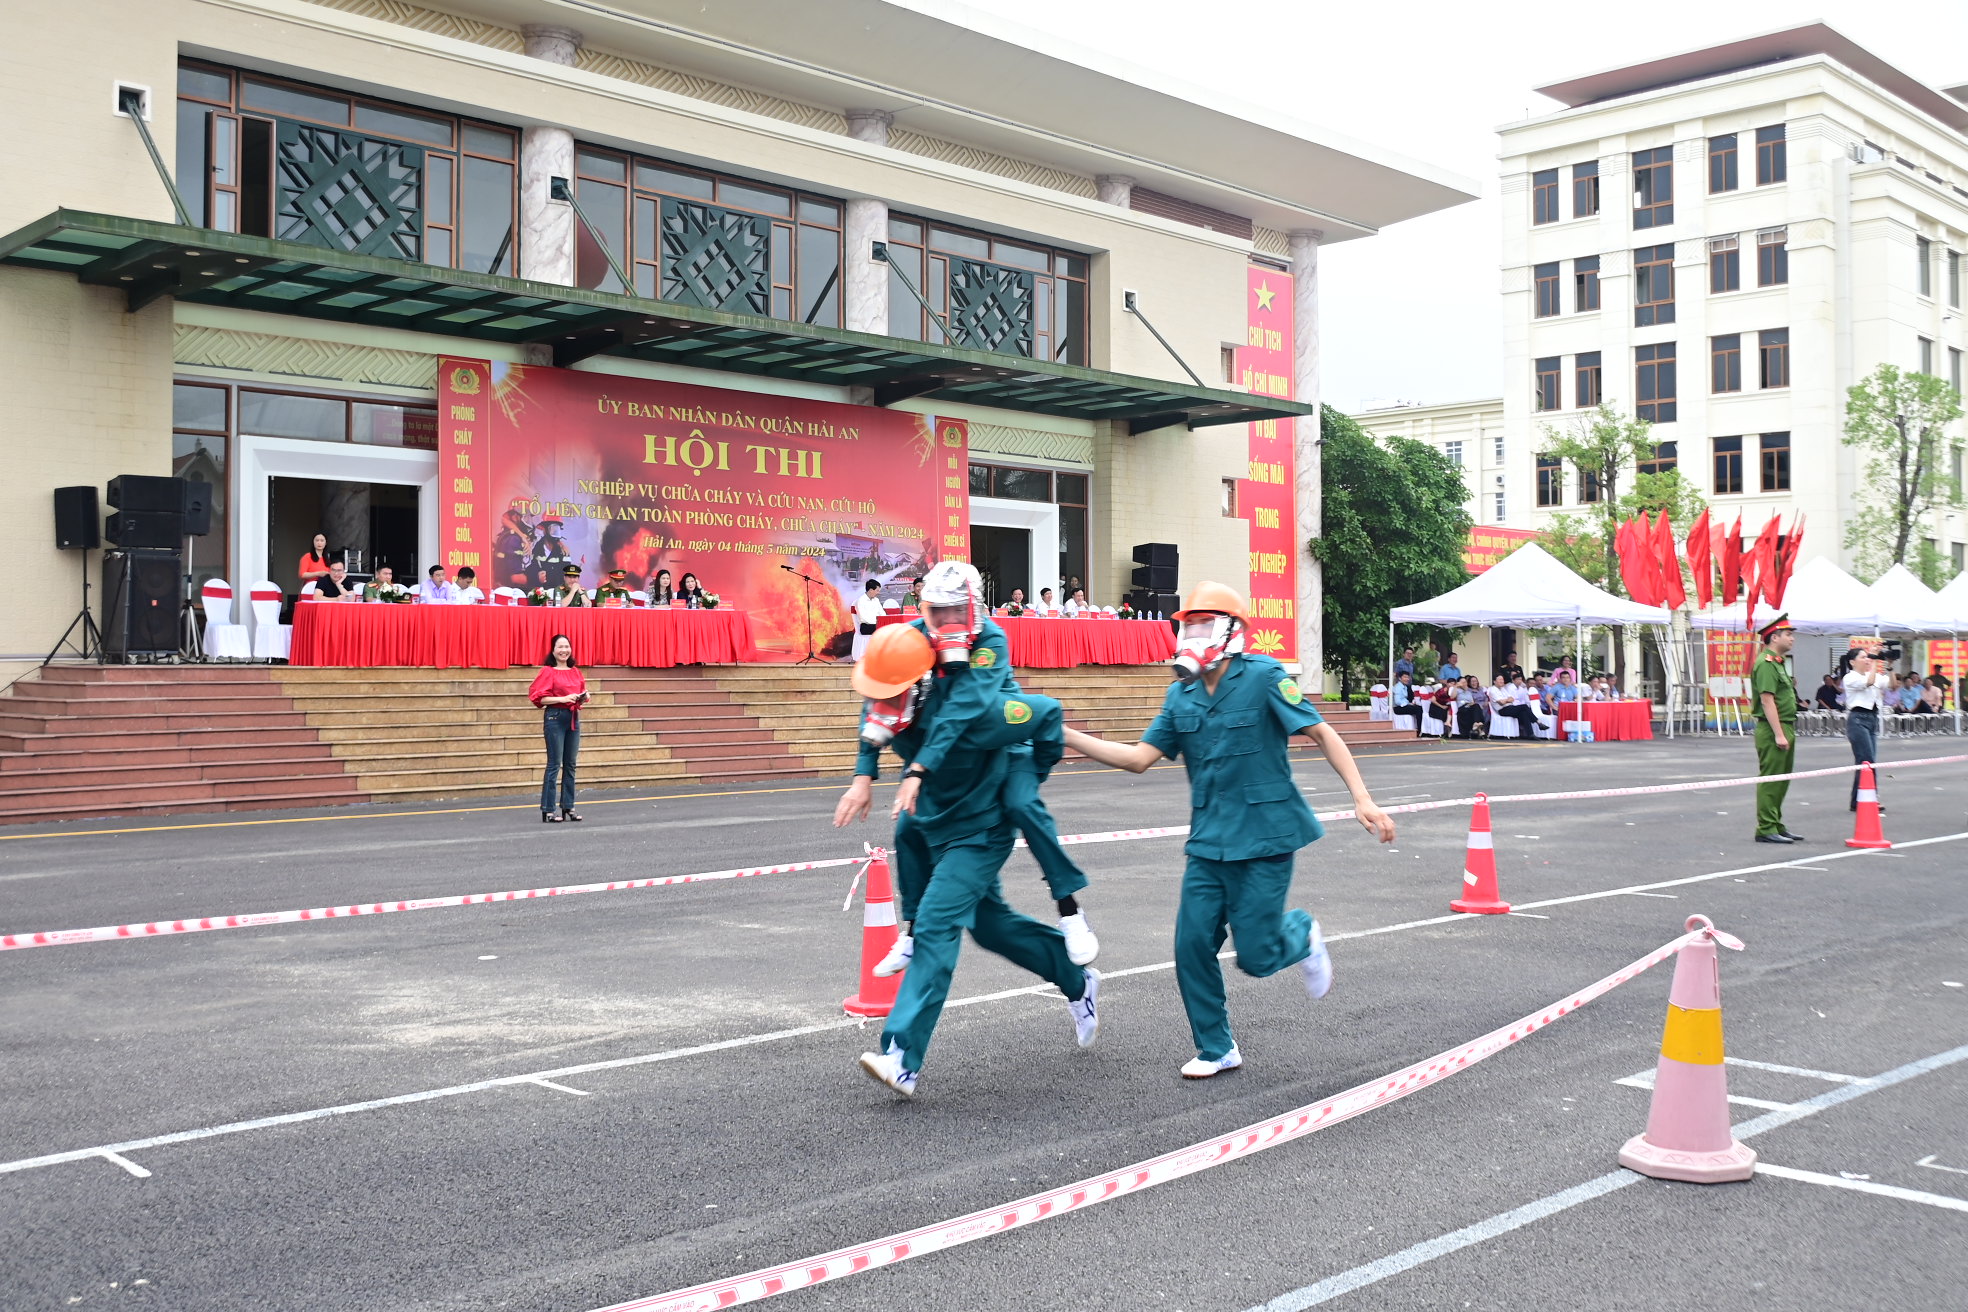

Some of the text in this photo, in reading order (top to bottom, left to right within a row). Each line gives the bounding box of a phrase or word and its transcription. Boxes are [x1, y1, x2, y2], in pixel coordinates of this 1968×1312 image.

[1249, 322, 1282, 354] CHỦ TỊCH
[1243, 364, 1288, 396] HỒ CHÍ MINH
[451, 403, 475, 422] PHÒNG
[598, 395, 860, 440] ỦY BAN NHÂN DÂN QUẬN HẢI AN
[454, 430, 472, 446] CHÁY
[456, 450, 470, 470] TỐT,
[642, 429, 824, 479] HỘI THI
[1249, 454, 1284, 484] SỐNG MÃI
[454, 476, 473, 494] CHỮA
[578, 478, 876, 516] NGHIỆP VỤ CHỮA CHÁY VÀ CỨU NẠN, CỨU HỘ
[956, 494, 962, 508] LÀ
[454, 500, 473, 518] CHÁY
[546, 498, 582, 518] LIÊN
[585, 504, 613, 520] GIA
[617, 508, 638, 521] AN
[642, 506, 682, 524] TOÀN
[686, 509, 733, 527] PHÒNG
[737, 514, 777, 532] CHÁY,
[781, 514, 816, 532] CHỮA
[868, 522, 895, 538] NĂM
[898, 527, 924, 540] 2024
[1255, 507, 1280, 529] TRONG
[456, 523, 472, 543] GIỎI,
[449, 548, 462, 566] CỨU
[644, 535, 664, 549] Hải
[666, 538, 684, 551] An,
[688, 540, 715, 554] ngày
[718, 541, 732, 552] 04
[734, 542, 764, 556] tháng
[767, 544, 773, 554] 5
[776, 544, 798, 556] năm
[800, 546, 826, 557] 2024
[1249, 550, 1287, 578] SỰ NGHIỆP
[1259, 594, 1284, 618] CHÚNG
[1285, 599, 1294, 619] TA
